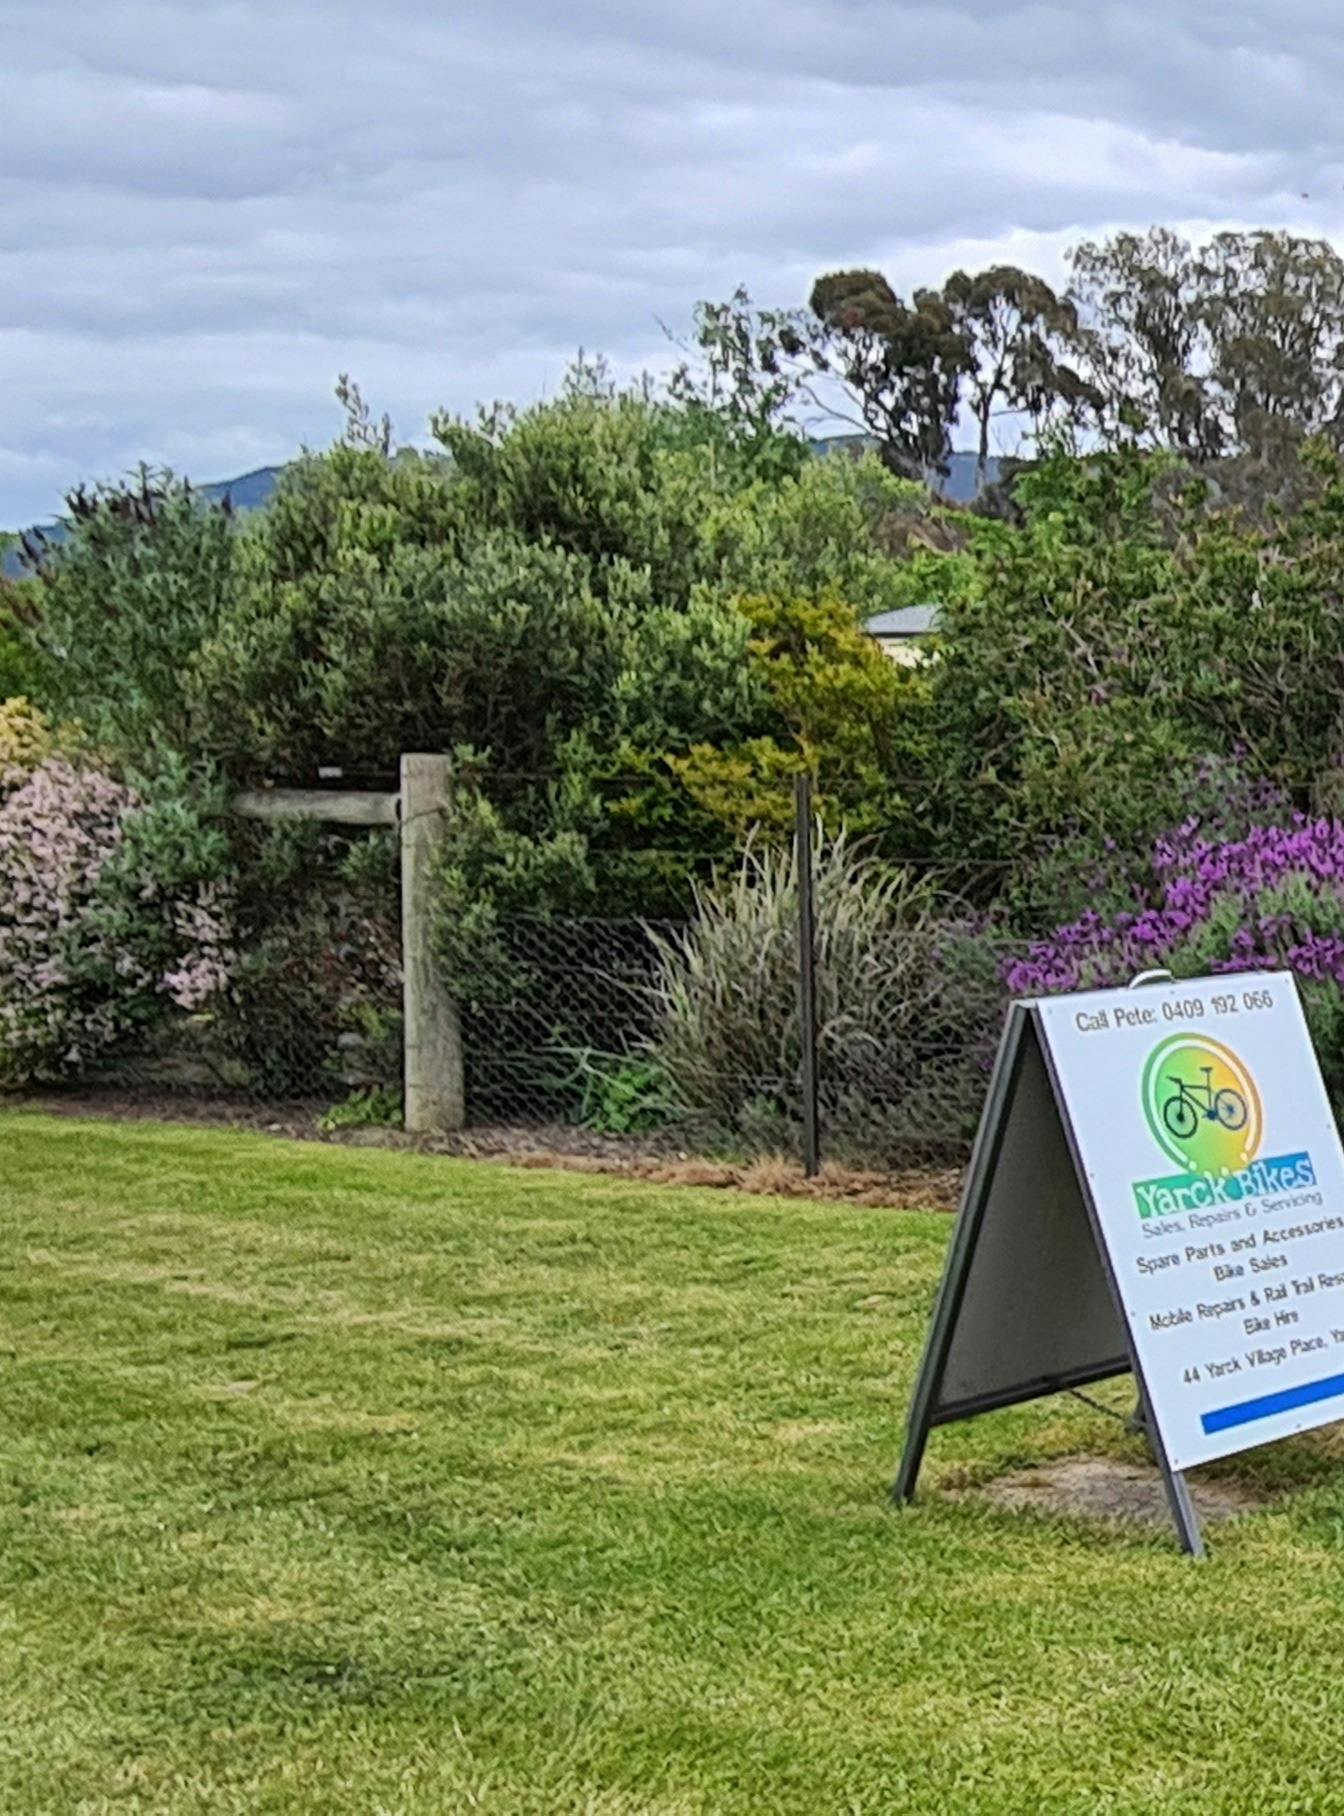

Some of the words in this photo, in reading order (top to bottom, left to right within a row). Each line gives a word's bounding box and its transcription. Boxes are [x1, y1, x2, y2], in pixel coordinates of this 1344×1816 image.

[1076, 1012, 1109, 1031] Call
[1114, 1007, 1158, 1028] Pete:
[1162, 998, 1204, 1020] 0409
[1211, 994, 1238, 1014] 192
[1243, 989, 1273, 1010] 066
[1136, 1171, 1228, 1217] Yarck
[1237, 1158, 1315, 1199] Bikes
[1141, 1221, 1184, 1239] Sales,
[1188, 1207, 1241, 1230] Repairs
[1263, 1191, 1323, 1213] Servicing
[1136, 1252, 1180, 1275] Spare
[1184, 1243, 1225, 1263] Parts
[1230, 1233, 1256, 1252] and
[1263, 1216, 1344, 1245] Accessories
[1213, 1264, 1245, 1281] Bike
[1250, 1254, 1288, 1273] Sales
[1149, 1308, 1193, 1330] Mobile
[1197, 1297, 1245, 1319] Repairs
[1250, 1291, 1260, 1307] &
[1264, 1283, 1288, 1303] Rail
[1291, 1277, 1315, 1296] Trail
[1244, 1318, 1271, 1335] Bike
[1274, 1310, 1299, 1327] Hire
[1183, 1368, 1200, 1384] 44
[1204, 1357, 1242, 1379] Yarck
[1245, 1347, 1287, 1369] Village
[1290, 1336, 1328, 1355] Place,
